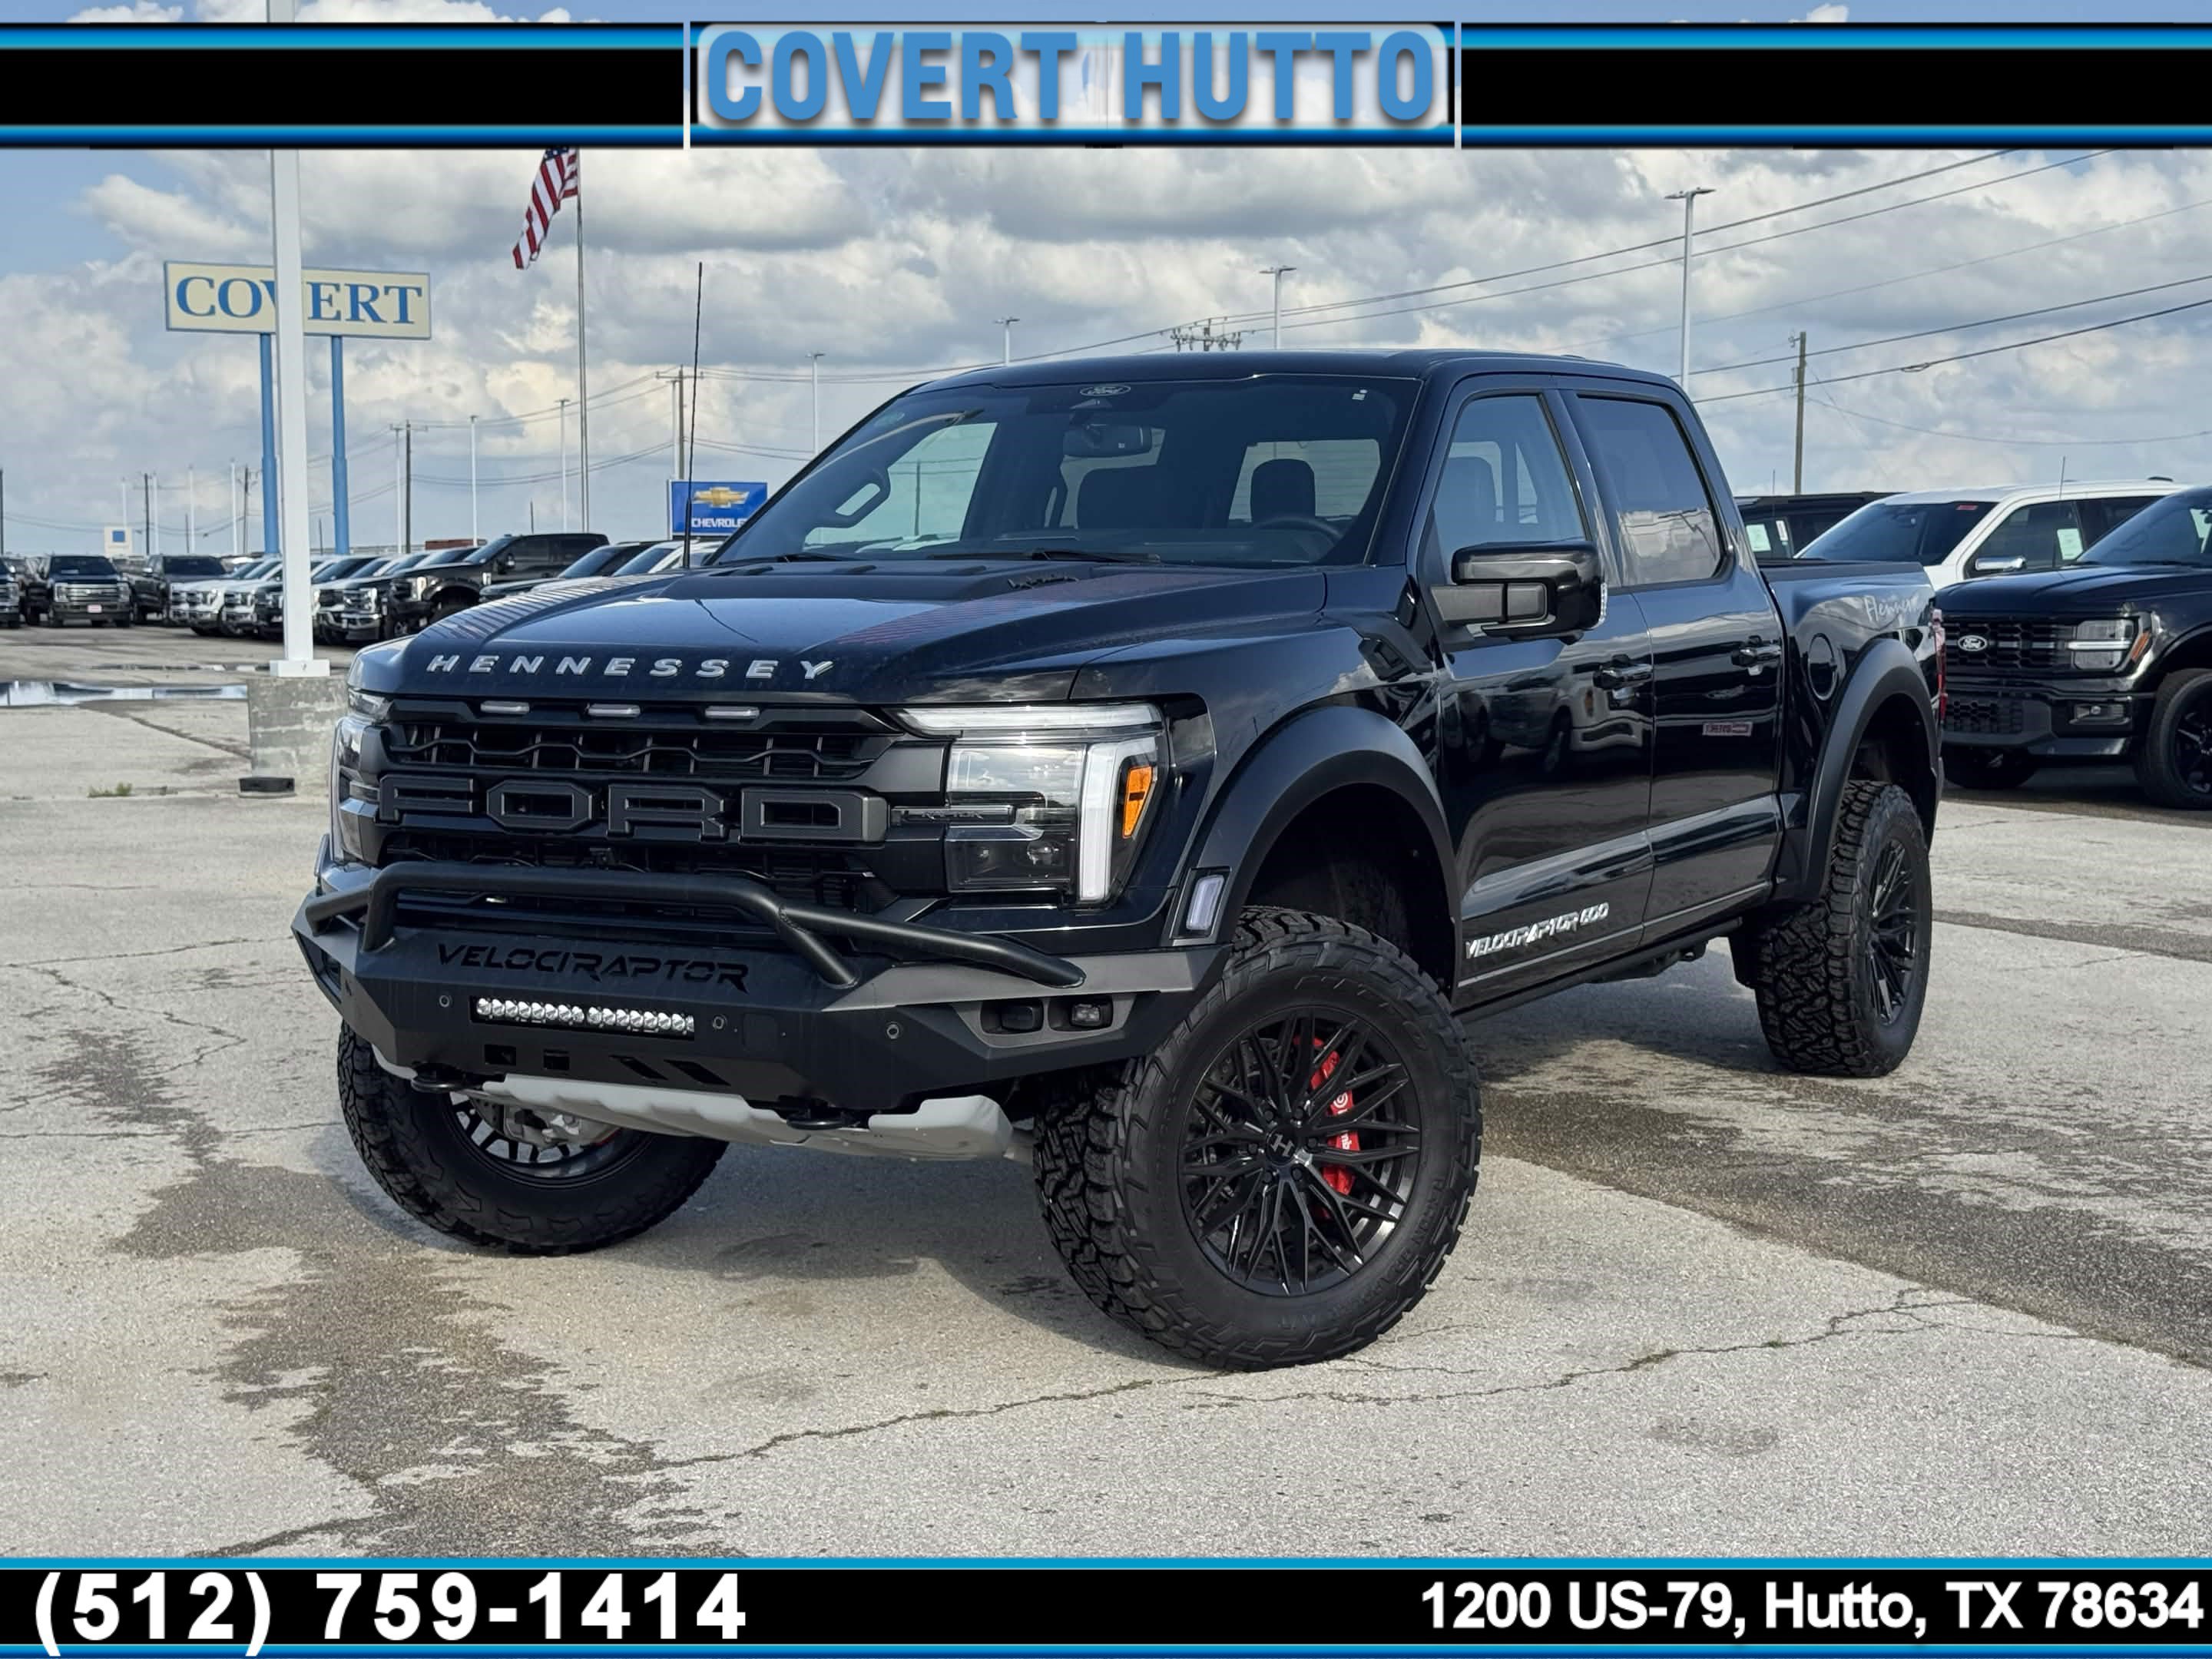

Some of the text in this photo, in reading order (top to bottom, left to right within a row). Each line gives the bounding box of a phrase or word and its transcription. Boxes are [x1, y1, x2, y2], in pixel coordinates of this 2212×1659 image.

[691, 518, 748, 528] CHEVROLE
[426, 654, 834, 680] HENNESSEY
[378, 774, 889, 843] FORD
[437, 943, 749, 995] VELOCIRAPTOR
